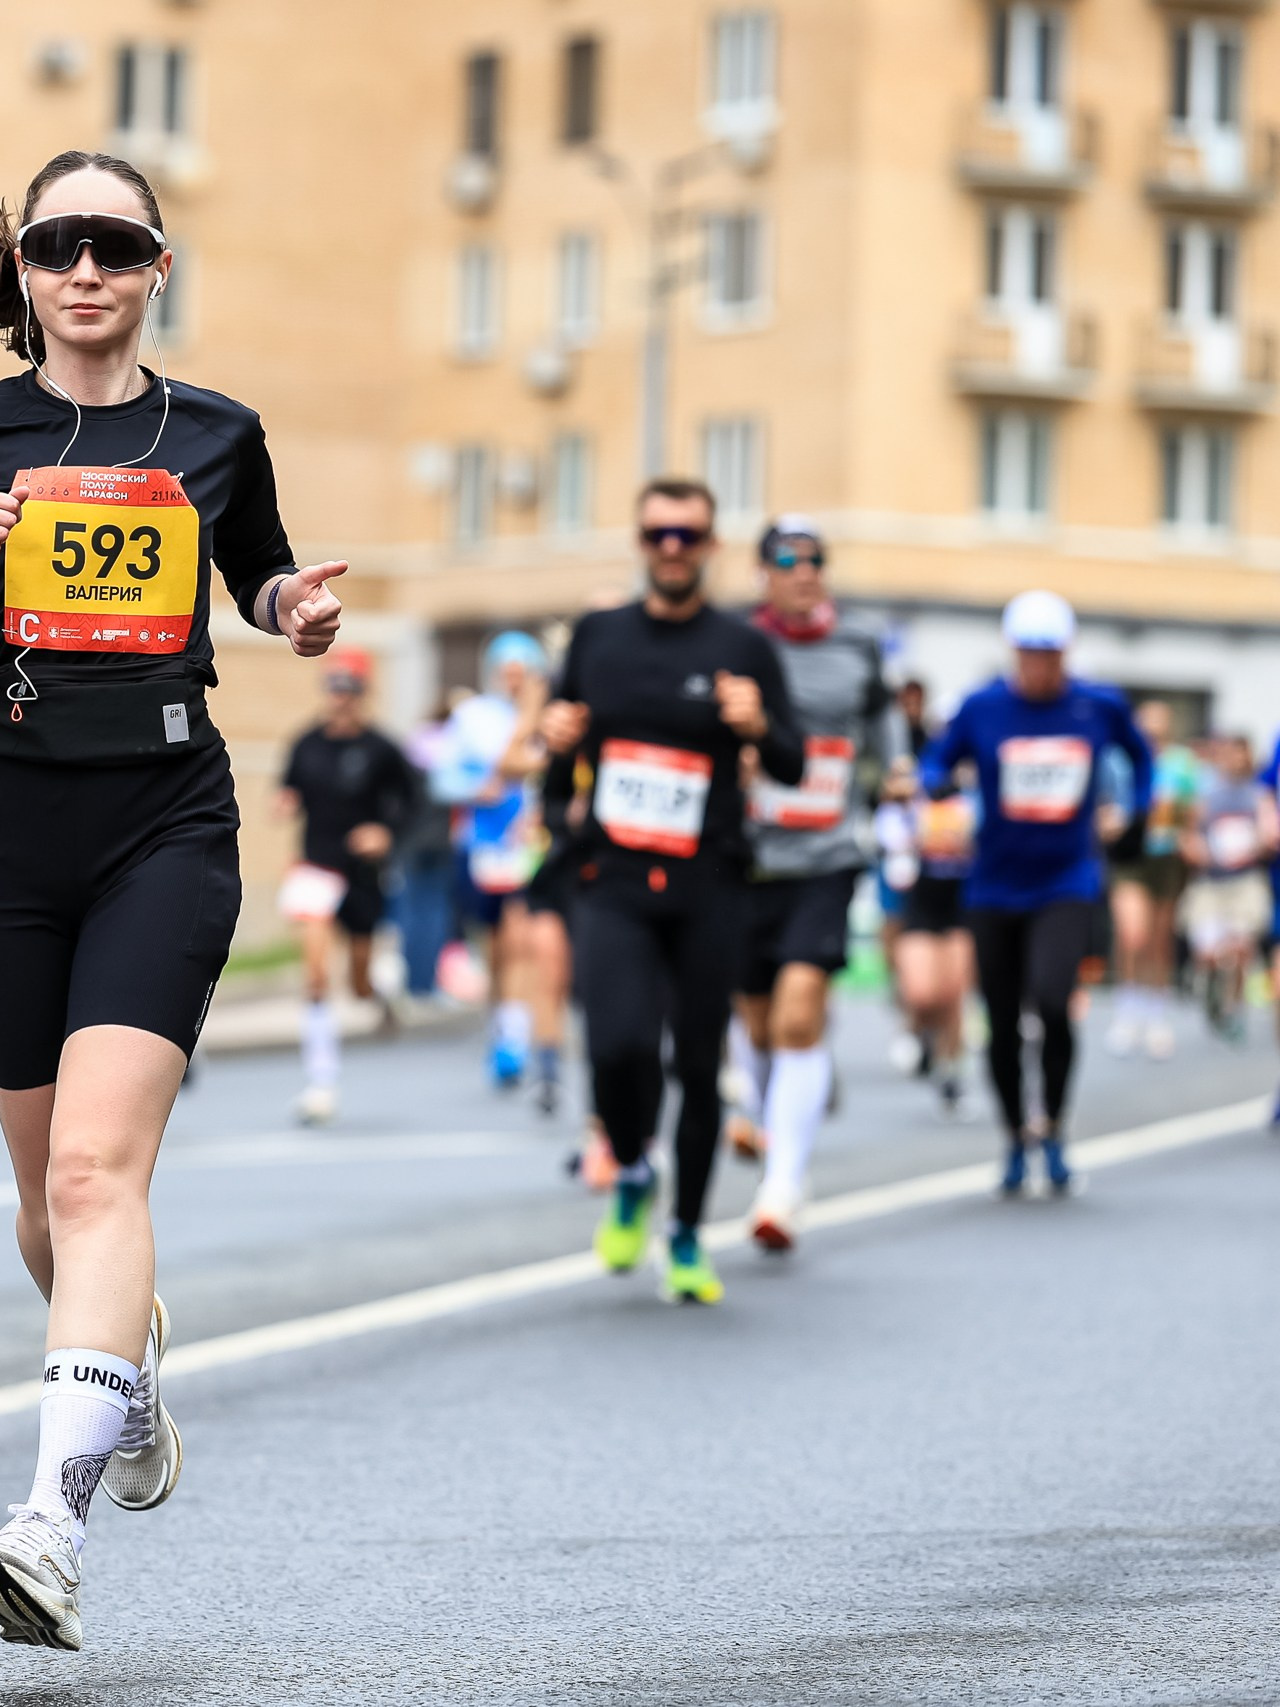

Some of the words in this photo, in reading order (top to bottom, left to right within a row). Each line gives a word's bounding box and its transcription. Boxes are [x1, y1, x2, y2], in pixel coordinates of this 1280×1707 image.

[81, 471, 148, 483] МОСКОВСКИЙ
[80, 480, 107, 490] ПОЛУ
[37, 486, 70, 496] 026
[79, 489, 129, 500] МАРАФОН
[51, 521, 162, 580] 593
[65, 584, 143, 602] ВАЛЕРИЯ
